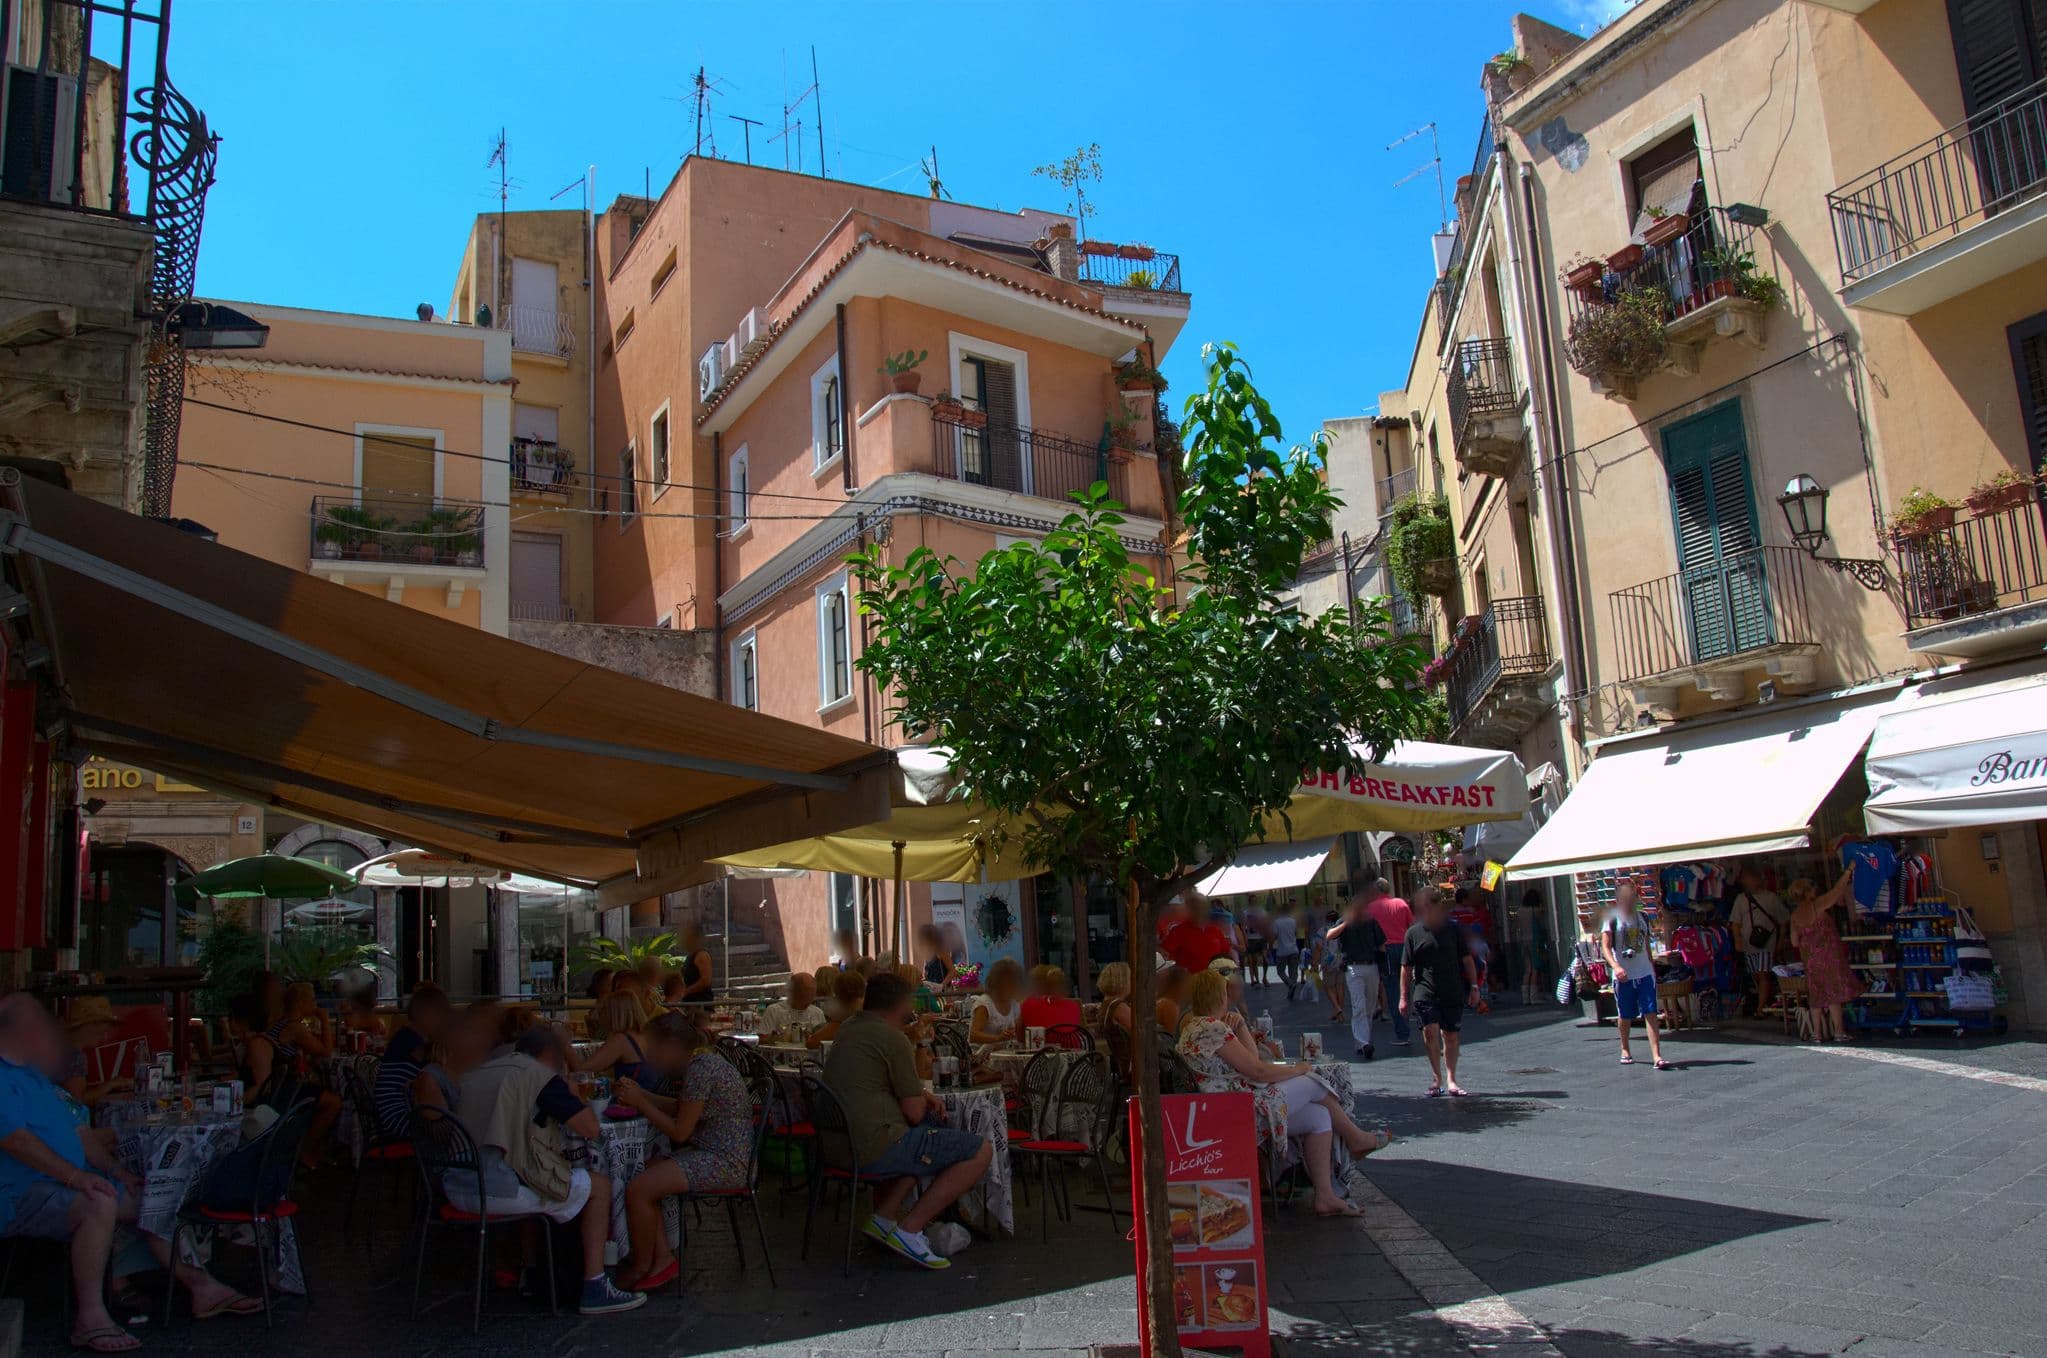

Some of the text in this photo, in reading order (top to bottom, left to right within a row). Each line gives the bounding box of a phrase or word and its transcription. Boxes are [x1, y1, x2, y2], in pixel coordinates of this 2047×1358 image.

[1349, 775, 1495, 808] BREAKFAST
[241, 821, 252, 830] 12
[1203, 1164, 1224, 1174] bar
